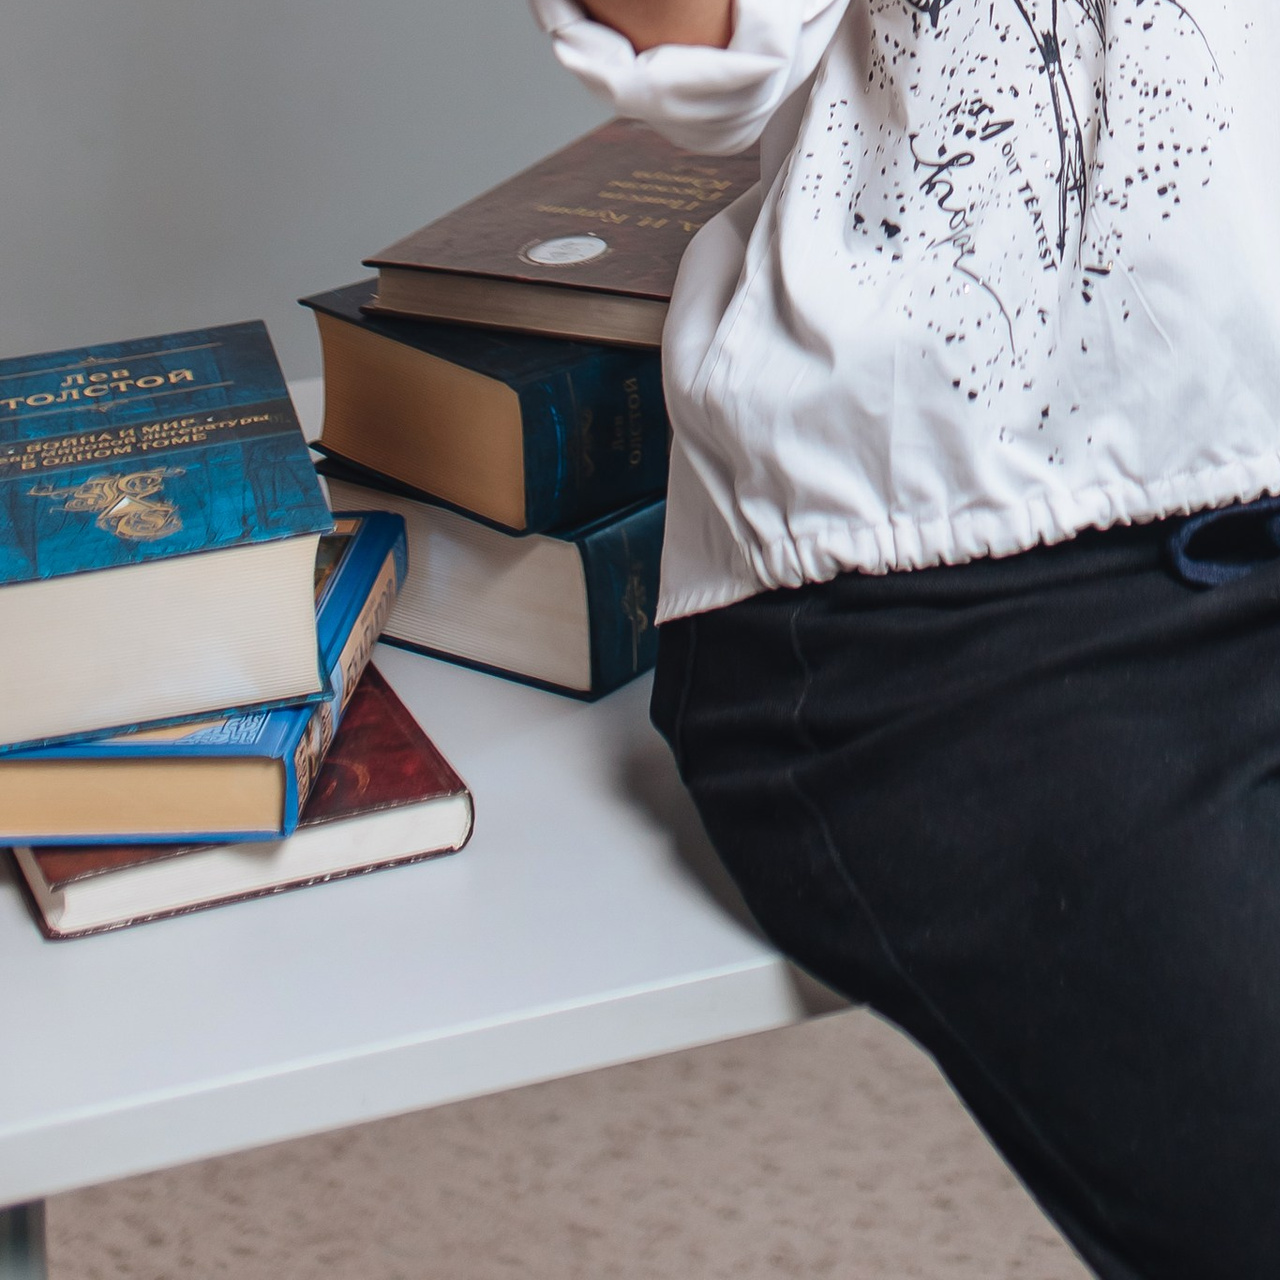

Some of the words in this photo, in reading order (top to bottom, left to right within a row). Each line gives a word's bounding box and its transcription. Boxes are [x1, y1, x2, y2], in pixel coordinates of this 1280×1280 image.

[1001, 142, 1023, 176] OUT
[1017, 180, 1058, 272] TEATEST
[0, 368, 195, 411] ТОЛСТОЙ
[60, 368, 130, 388] Лев
[26, 431, 113, 453] ВОЙНА
[119, 427, 135, 438] И
[141, 417, 196, 434] МИР
[623, 377, 643, 466] ОЛСТОЙ
[42, 443, 132, 467] ОДНОМ
[138, 432, 208, 452] ТОМЕ
